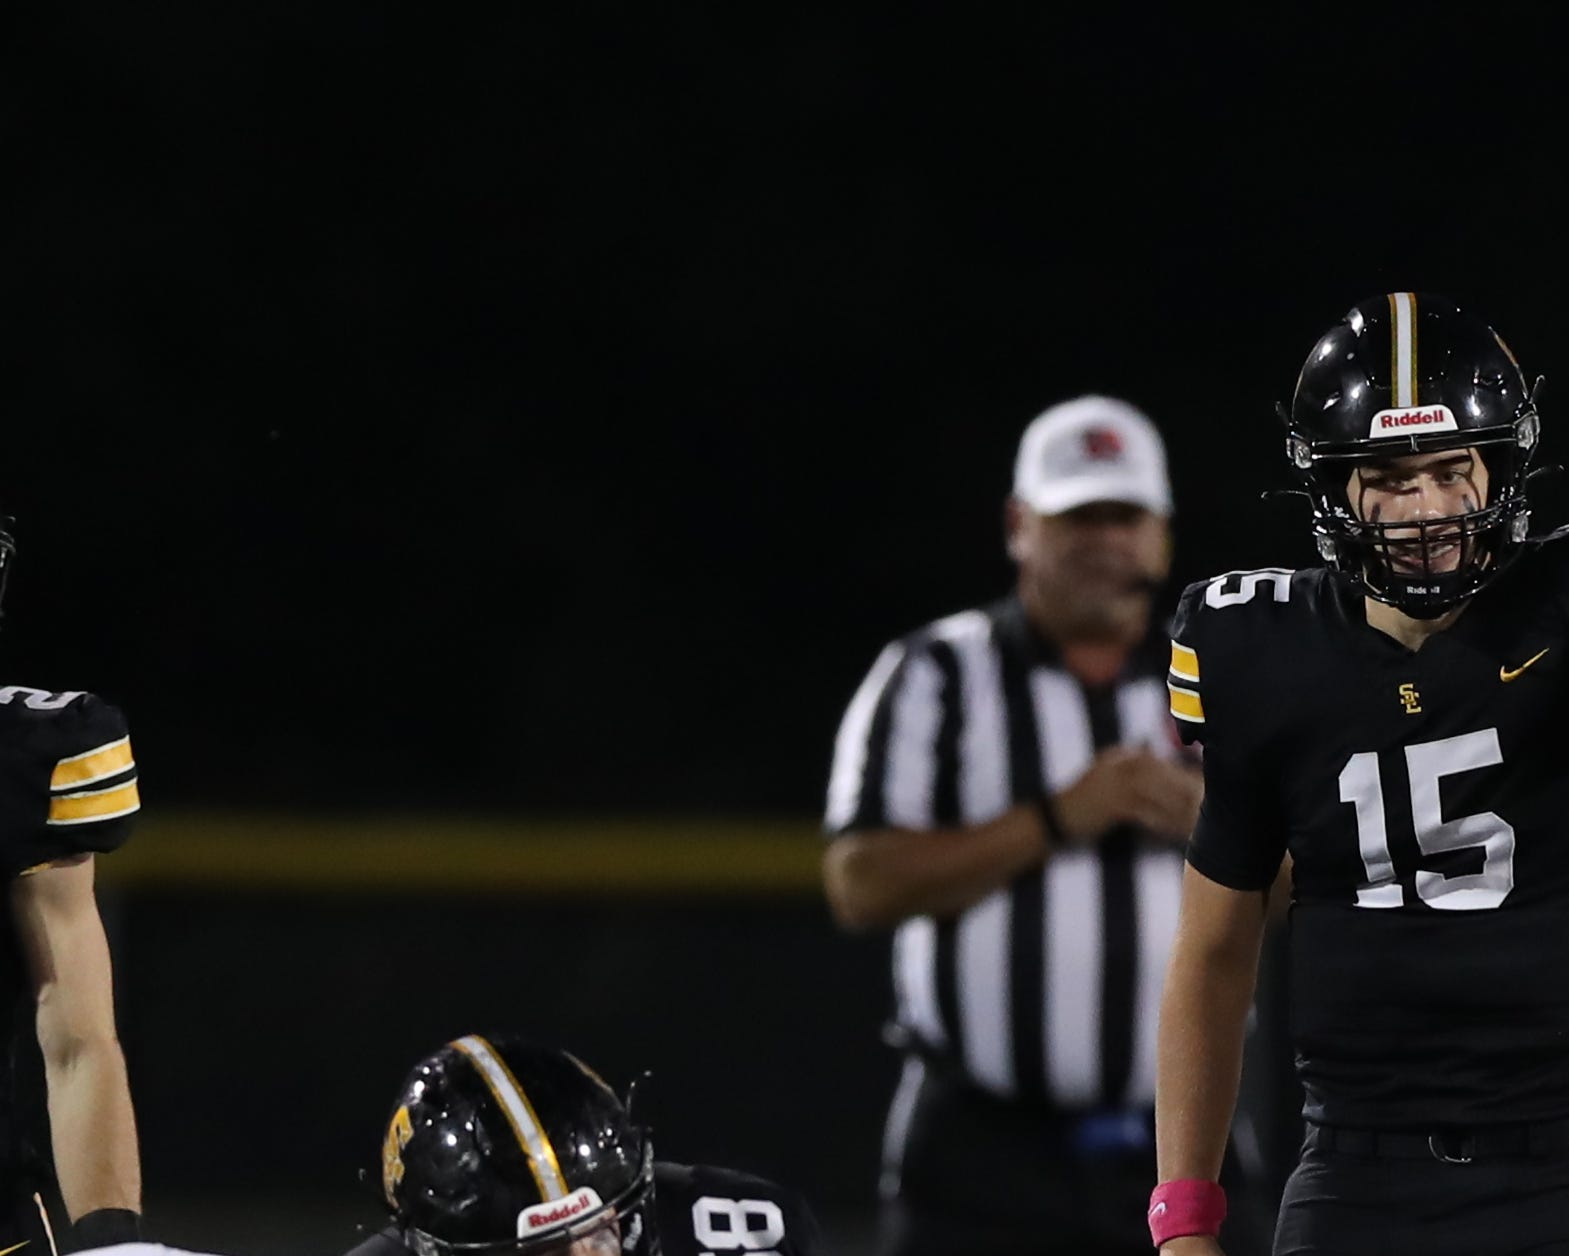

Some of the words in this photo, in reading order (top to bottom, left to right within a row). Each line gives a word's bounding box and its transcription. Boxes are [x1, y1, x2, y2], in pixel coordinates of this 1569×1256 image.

[1380, 409, 1444, 428] Riddell
[1338, 728, 1515, 910] 15
[528, 1194, 590, 1228] Riddell
